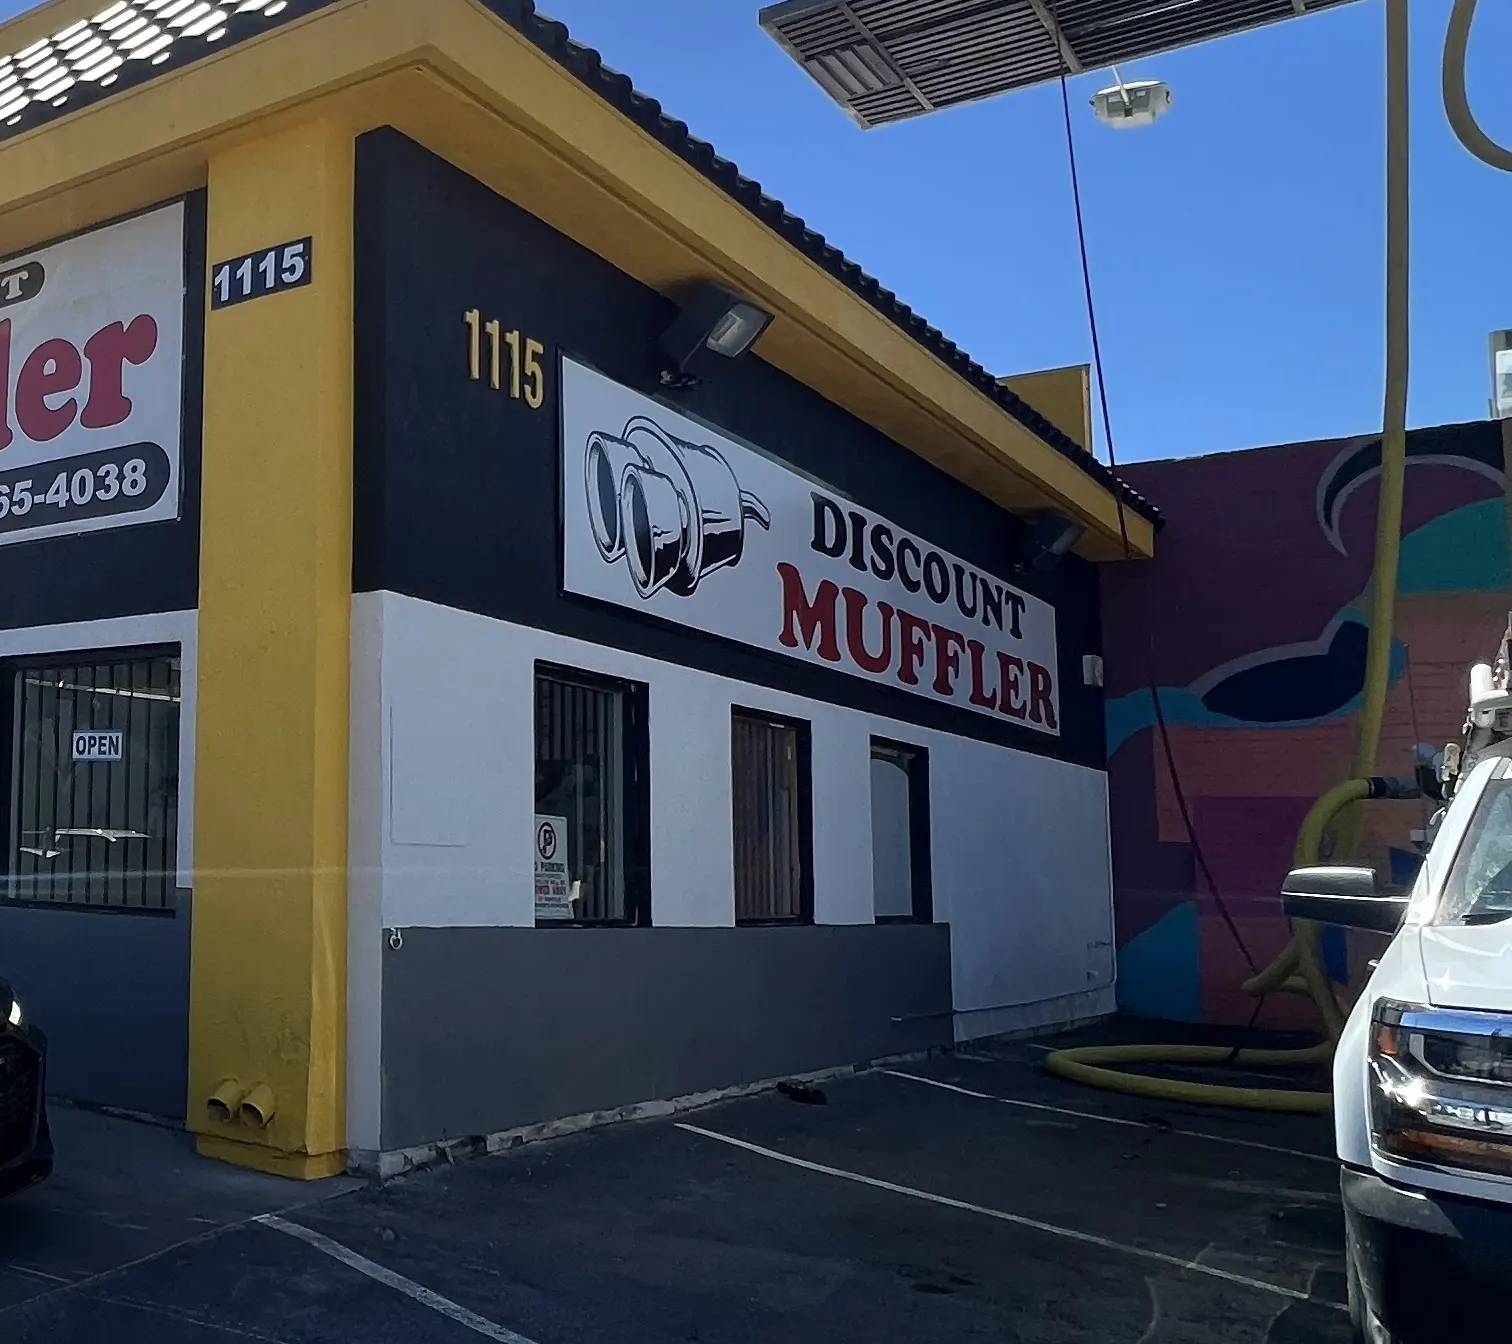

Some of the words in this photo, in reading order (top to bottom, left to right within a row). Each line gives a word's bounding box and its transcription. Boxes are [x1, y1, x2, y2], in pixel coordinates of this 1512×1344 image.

[214, 243, 305, 303] 1115
[464, 308, 544, 409] 1115
[809, 490, 1026, 640] DISCOUNT
[775, 561, 1058, 730] MUFFLER
[75, 735, 120, 756] OPEN
